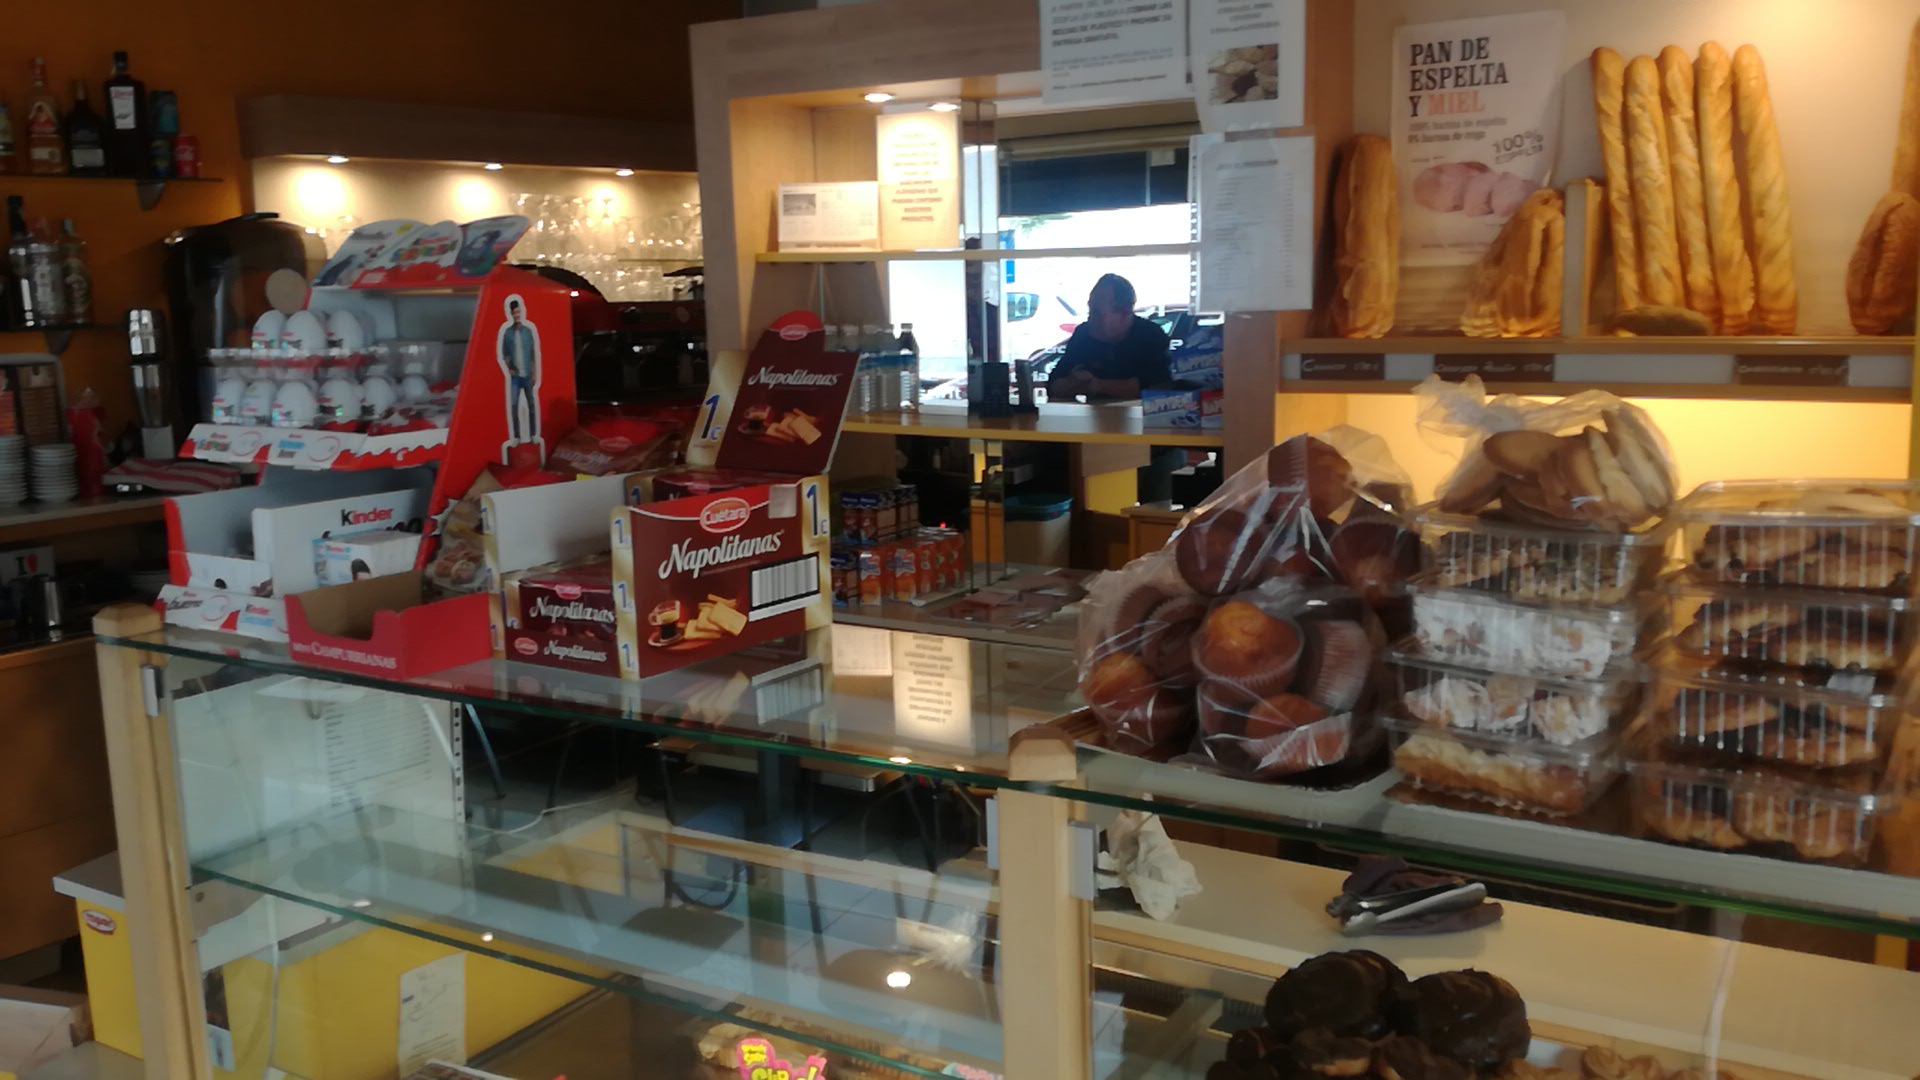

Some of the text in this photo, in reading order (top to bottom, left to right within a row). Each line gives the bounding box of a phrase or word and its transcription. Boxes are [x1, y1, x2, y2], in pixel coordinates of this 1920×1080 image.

[1410, 37, 1490, 66] PAN DE
[1409, 62, 1509, 92] ESPELTA
[1409, 91, 1486, 118] Y MIEL
[1493, 129, 1544, 153] 100%
[748, 365, 843, 389] Napolitanas
[658, 532, 782, 579] Napolitanas
[529, 596, 615, 623] Napolitanas
[544, 640, 607, 660] Napolitanas
